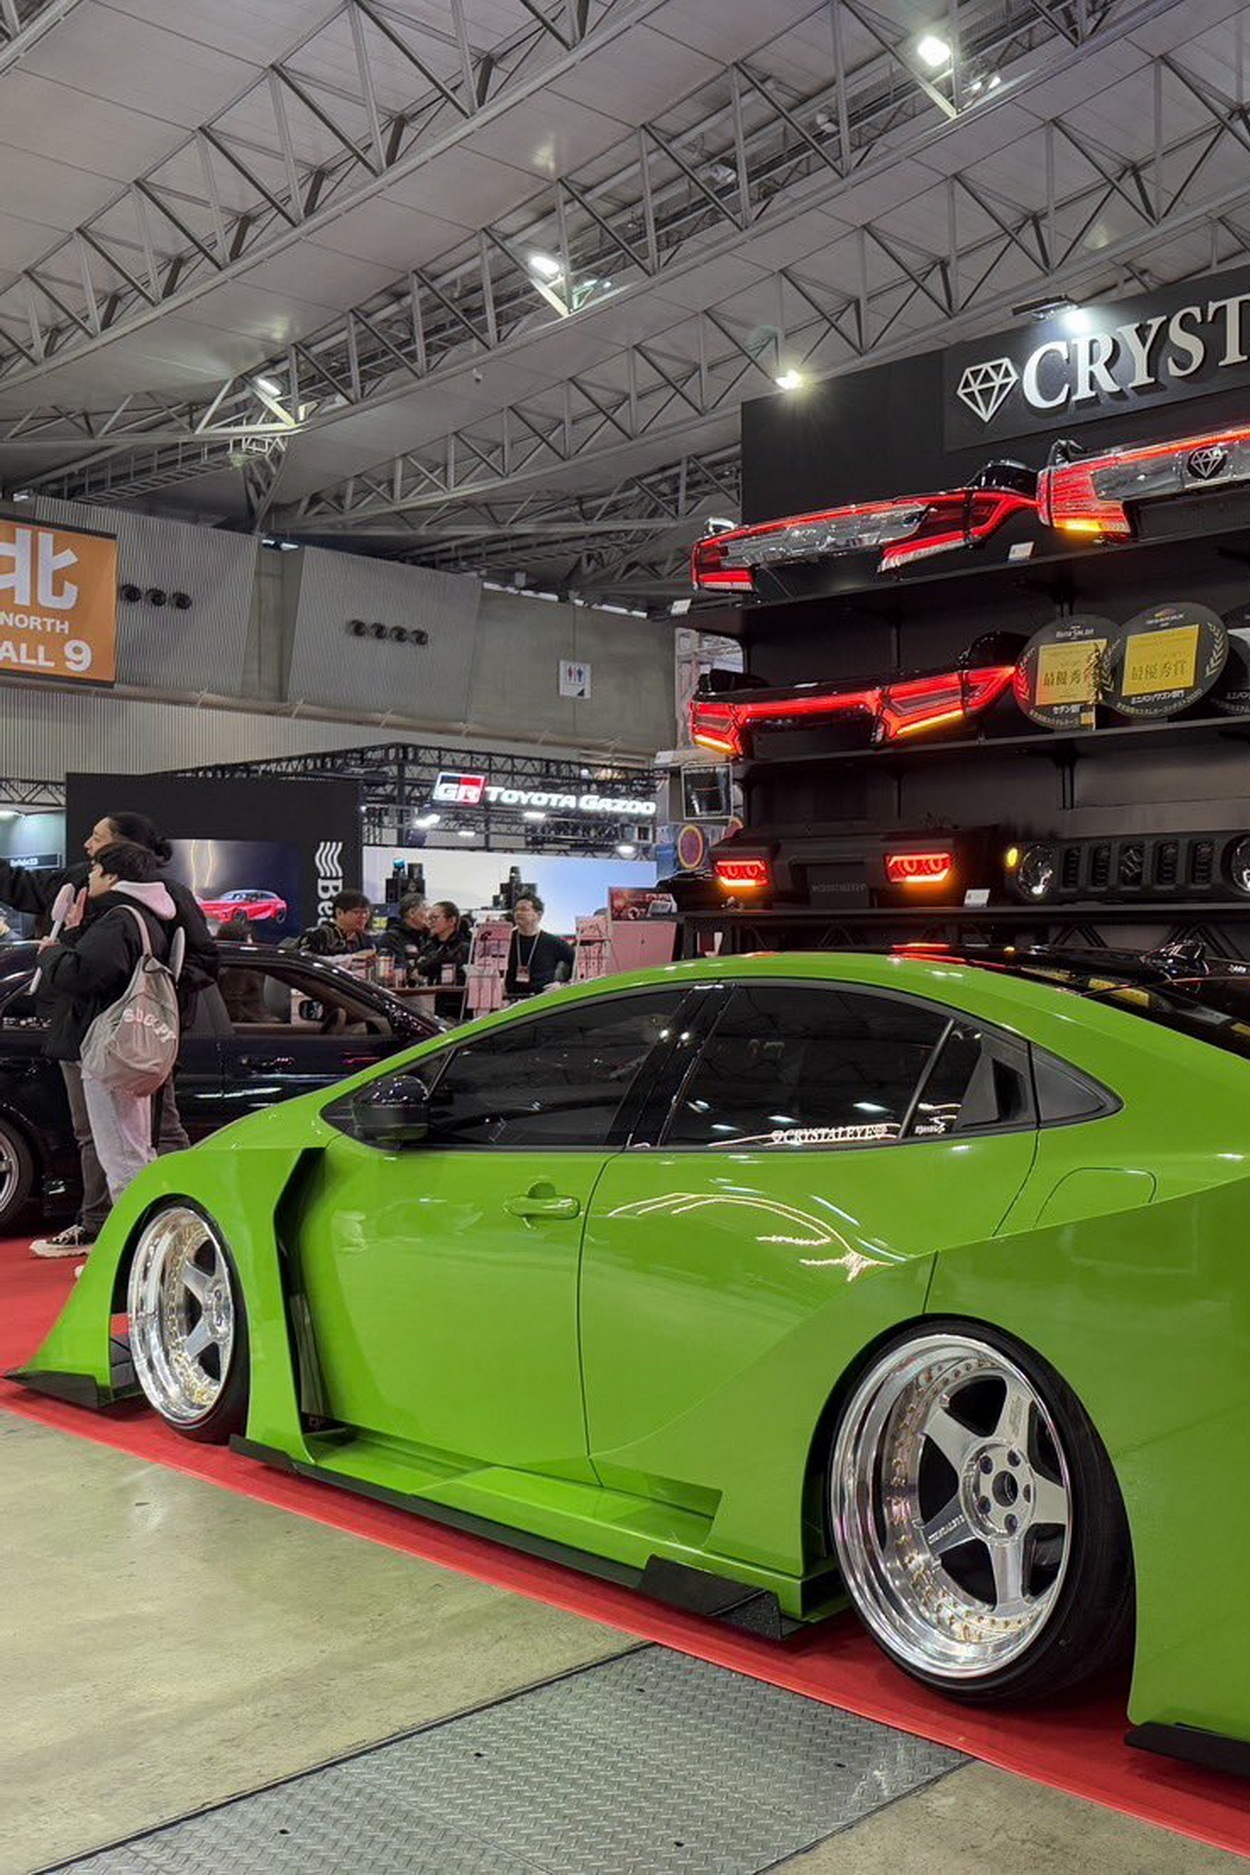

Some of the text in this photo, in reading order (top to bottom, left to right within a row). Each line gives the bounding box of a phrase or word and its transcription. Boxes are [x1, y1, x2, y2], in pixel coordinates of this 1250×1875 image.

[0, 612, 70, 635] NORTH
[63, 639, 93, 673] 9
[433, 783, 657, 815] GR TOYOTA GAZOO
